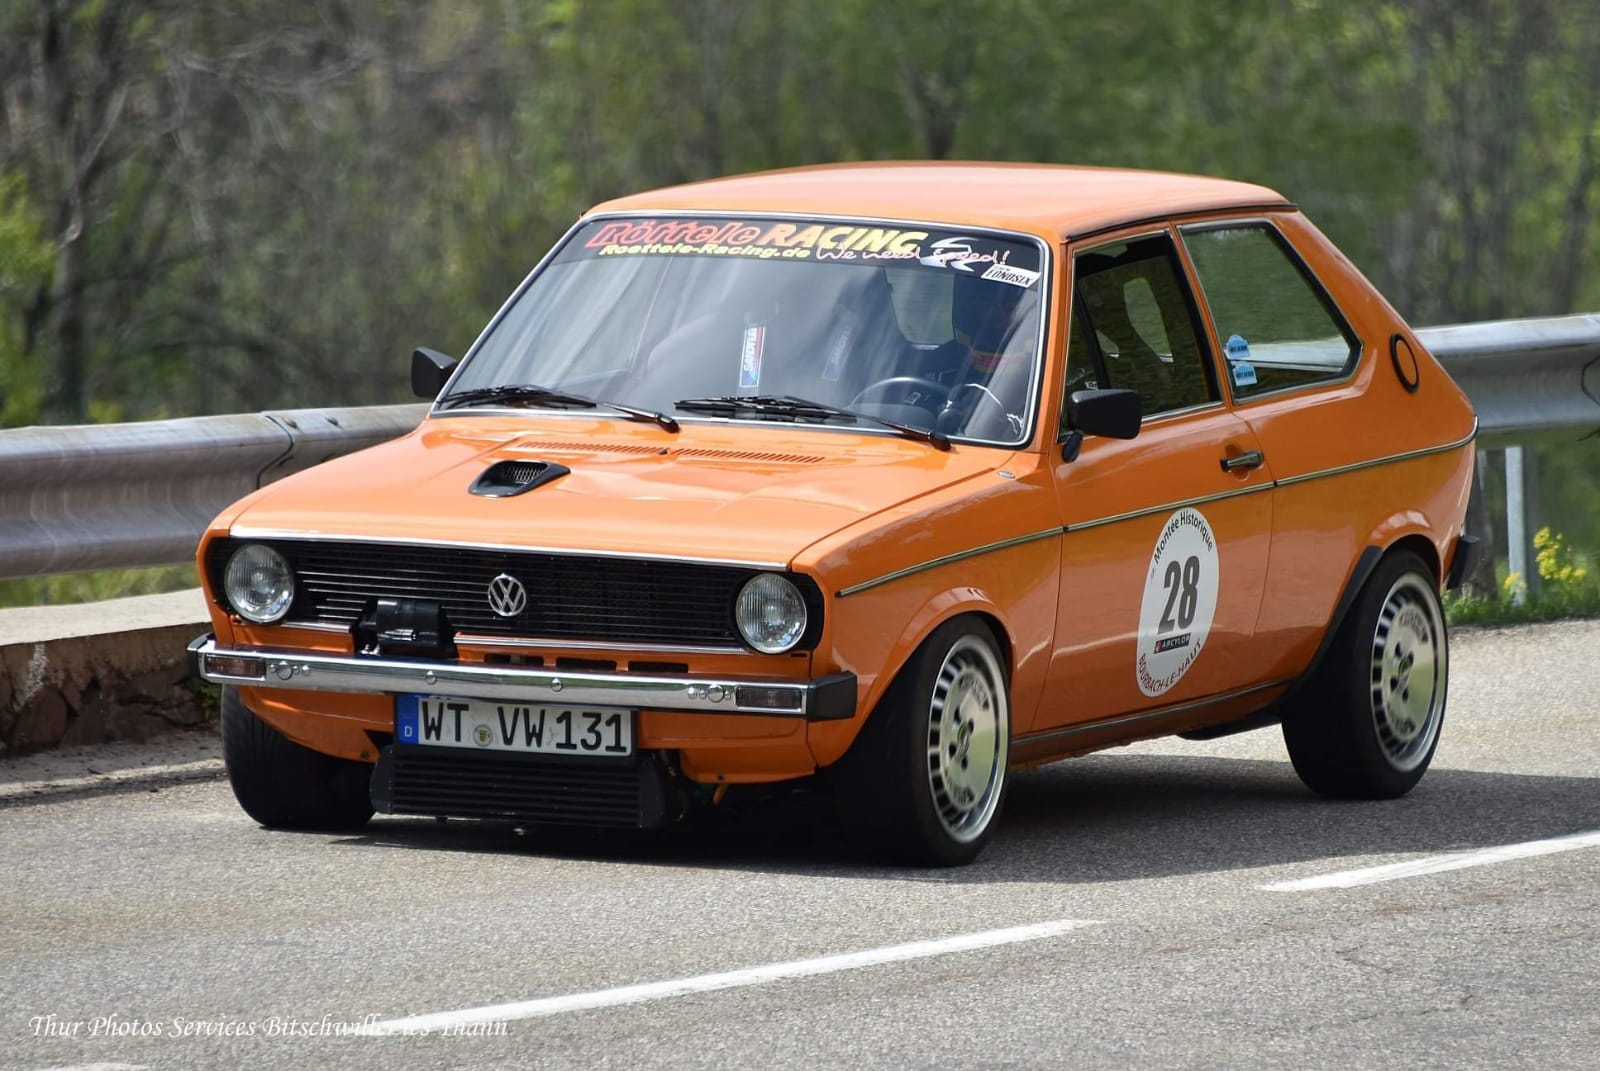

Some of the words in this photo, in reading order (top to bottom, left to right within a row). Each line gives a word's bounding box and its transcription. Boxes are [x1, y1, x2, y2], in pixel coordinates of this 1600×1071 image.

[599, 244, 811, 258] Roettele-Racing.de
[759, 224, 929, 252] RACING
[815, 242, 857, 260] We
[862, 246, 921, 260] need
[1154, 517, 1179, 565] Montée
[1180, 510, 1213, 552] Historique
[1157, 555, 1200, 635] 28
[403, 726, 413, 737] D
[422, 701, 469, 742] WT
[497, 706, 546, 747] VW
[555, 711, 627, 753] 131
